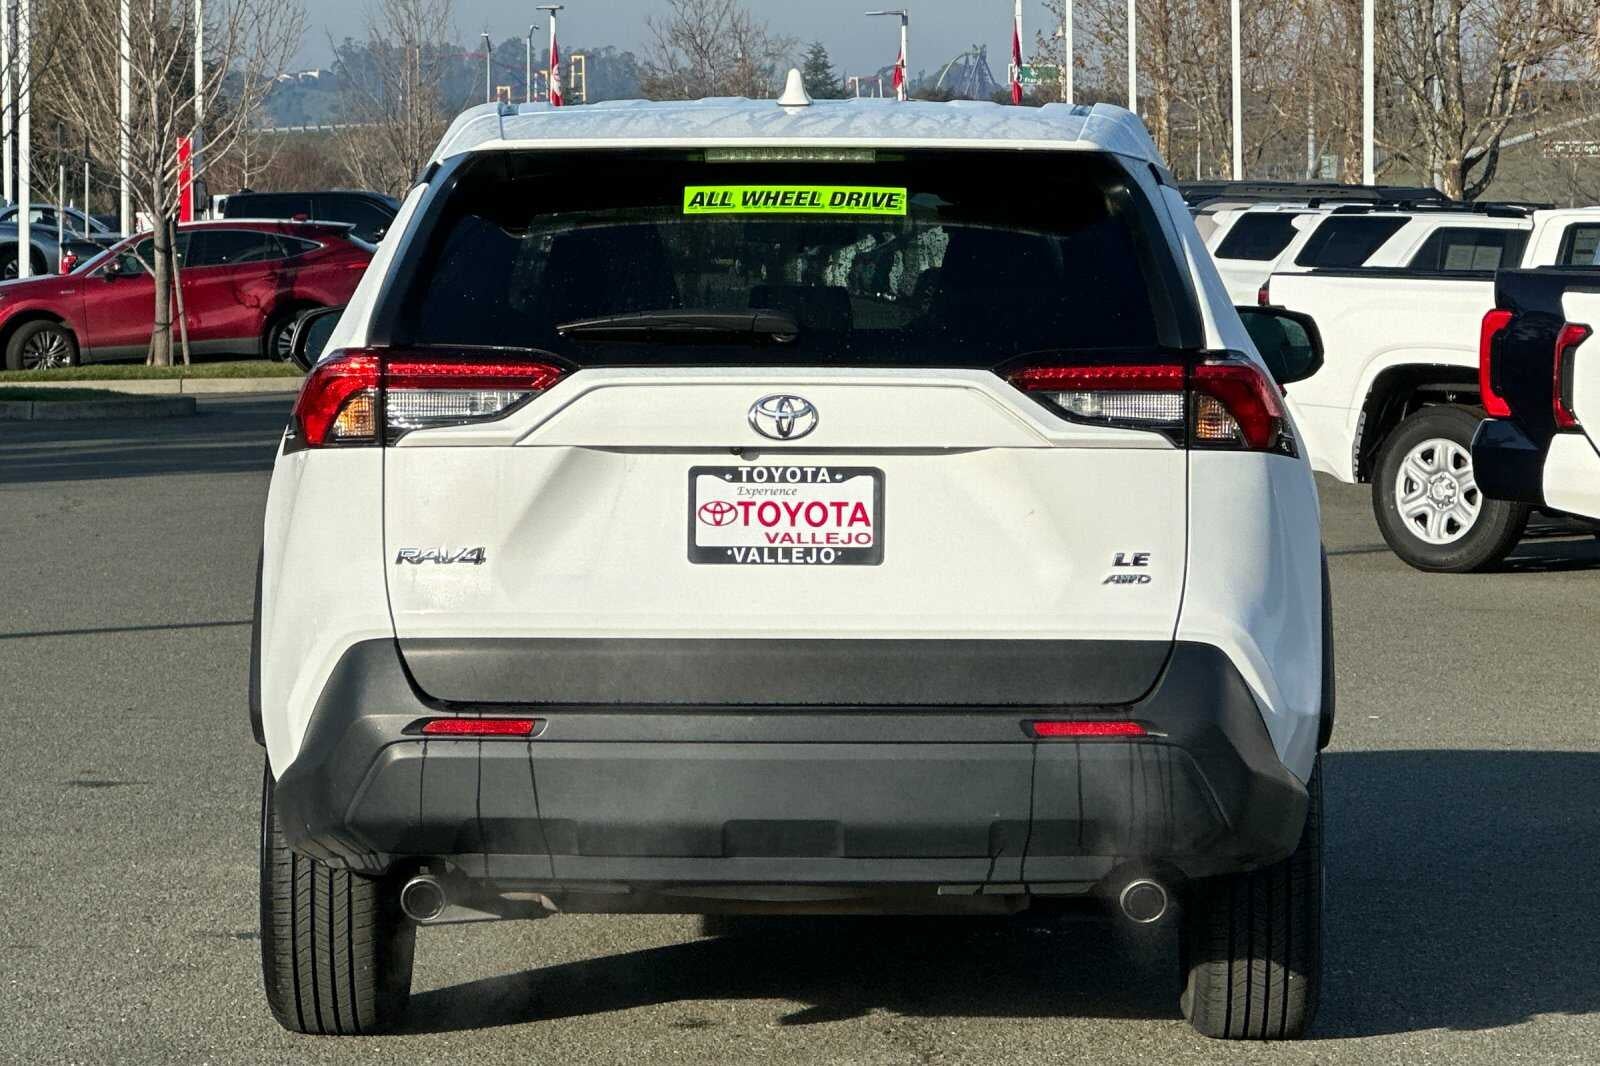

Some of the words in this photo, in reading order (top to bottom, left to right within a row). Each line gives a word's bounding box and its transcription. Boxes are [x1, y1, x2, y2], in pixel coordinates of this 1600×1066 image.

[688, 191, 733, 208] ALL
[741, 191, 823, 208] WHEEL
[829, 191, 904, 209] DRIVE
[738, 467, 831, 483] TOYOTA
[737, 486, 798, 498] Experience
[736, 501, 871, 527] TOYOTA
[765, 532, 872, 545] VALLEJO
[395, 546, 487, 565] RAV4
[732, 548, 836, 564] VALLEJO
[1112, 552, 1151, 567] LE
[1101, 574, 1152, 585] AWD
